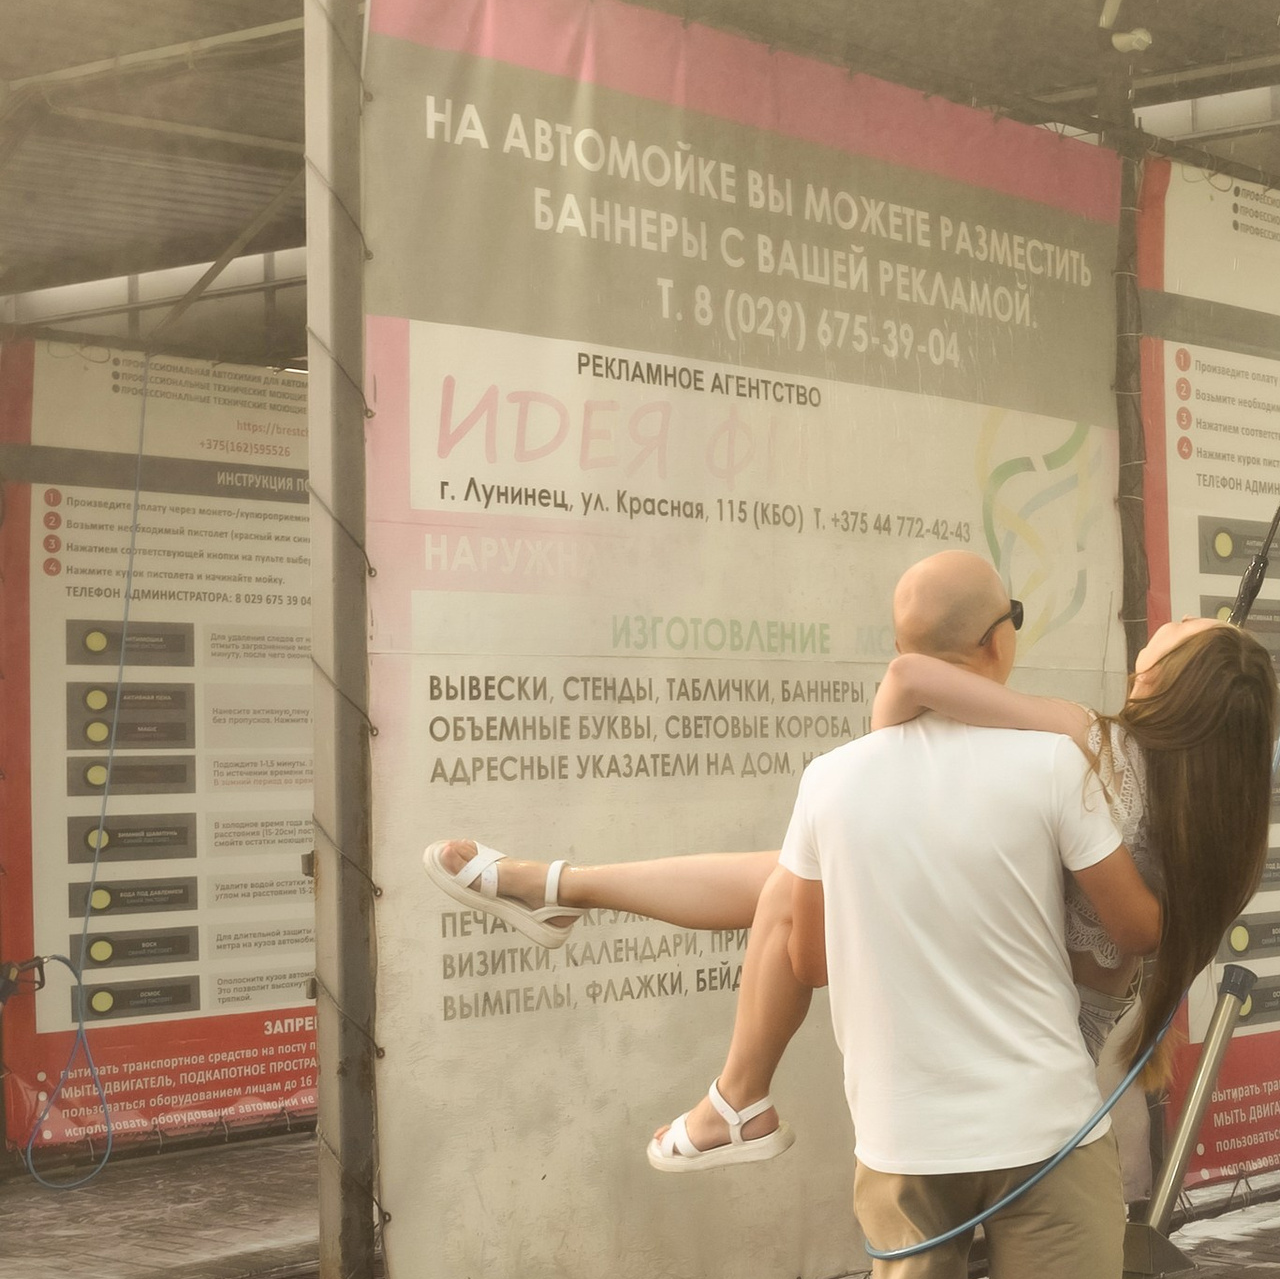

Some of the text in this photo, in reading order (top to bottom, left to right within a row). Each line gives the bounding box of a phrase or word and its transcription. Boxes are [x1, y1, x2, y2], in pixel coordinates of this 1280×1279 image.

[426, 95, 1092, 287] НА АВТОМОЙКЕ ВЫ МОЖЕТЕ РАЗМЕСТИТЬ
[534, 187, 1038, 329] БАННЕРЫ С ВАШЕЙ РЕКЛАМОЙ.
[657, 277, 962, 369] Т. 8 (029) 675-39-04
[577, 352, 822, 408] РЕКЛАМНОЕ АГЕНТСТВО
[1195, 359, 1249, 382] Произведите
[1251, 373, 1278, 390] оплату
[213, 383, 267, 398] ТЕХНИЧЕСКИЕ
[213, 396, 267, 411] ТЕХНИЧЕСКИЕ
[1195, 389, 1236, 407] Возьмите
[1196, 418, 1239, 435] Нажатием
[199, 438, 291, 457] +375(162)595526
[1196, 447, 1262, 469] Нажмите курок
[217, 471, 293, 492] ИНСТРУКЦИЯ
[1196, 473, 1243, 492] ТЕЛЕФОН
[66, 496, 131, 511] Произведите
[169, 505, 196, 516] через
[441, 477, 971, 543] г. Лунинец, ул. Красная, 115 (КБО) Т. +375 44 772-42-43
[66, 519, 114, 532] Возьмите
[188, 527, 228, 540] пистолет
[230, 529, 272, 542] (красный
[274, 533, 290, 543] или
[66, 542, 283, 566] Нажатием соответствующей кнопки на пульте
[66, 565, 113, 578] Нажмите
[147, 570, 194, 581] пистолета
[196, 573, 203, 581] и
[205, 572, 252, 585] начинайте
[255, 574, 285, 586] мойку.
[65, 586, 311, 607] ТЕЛЕФОН АДМИНИСТРАТОРА: 8 029 675 39 04
[611, 615, 832, 655] ИЗГОТОВЛЕНИЕ
[429, 675, 555, 706] ВЫВЕСКИ,
[562, 676, 661, 706] СТЕНДЫ,
[667, 679, 775, 705] ТАБЛИЧКИ,
[781, 679, 870, 705] БАННЕРЫ,
[429, 715, 571, 742] ОБЪЕМНЫЕ
[579, 715, 658, 742] БУКВЫ,
[665, 714, 769, 740] СВЕТОВЫЕ
[776, 714, 857, 740] КОРОБА,
[430, 755, 568, 786] АДРЕСНЫЕ
[576, 753, 700, 781] УКАЗАТЕЛИ
[707, 753, 735, 778] НА
[741, 751, 796, 780] ДОМ,
[441, 910, 518, 938] ПЕЧА
[443, 946, 557, 981] ВИЗИТКИ,
[566, 931, 705, 968] КАЛЕНДАРИ,
[444, 982, 579, 1022] ВЫМПЕЛЫ,
[585, 971, 690, 1004] ФЛАЖКИ,
[122, 1053, 205, 1074] транспортное
[207, 1048, 258, 1065] средство
[261, 1046, 274, 1057] на
[277, 1042, 308, 1056] посту
[61, 1084, 101, 1100] МЫТЬ
[104, 1077, 176, 1098] ДВИГАТЕЛЬ,
[179, 1064, 266, 1086] ПОДКАПОТНОЕ
[1211, 1084, 1261, 1103] вытирать
[61, 1075, 312, 1121] пользоваться оборудованием лицам до 16
[151, 1105, 235, 1127] оборудование
[238, 1096, 299, 1115] автомойки
[301, 1094, 314, 1105] не
[1213, 1111, 1247, 1128] МЫТЬ
